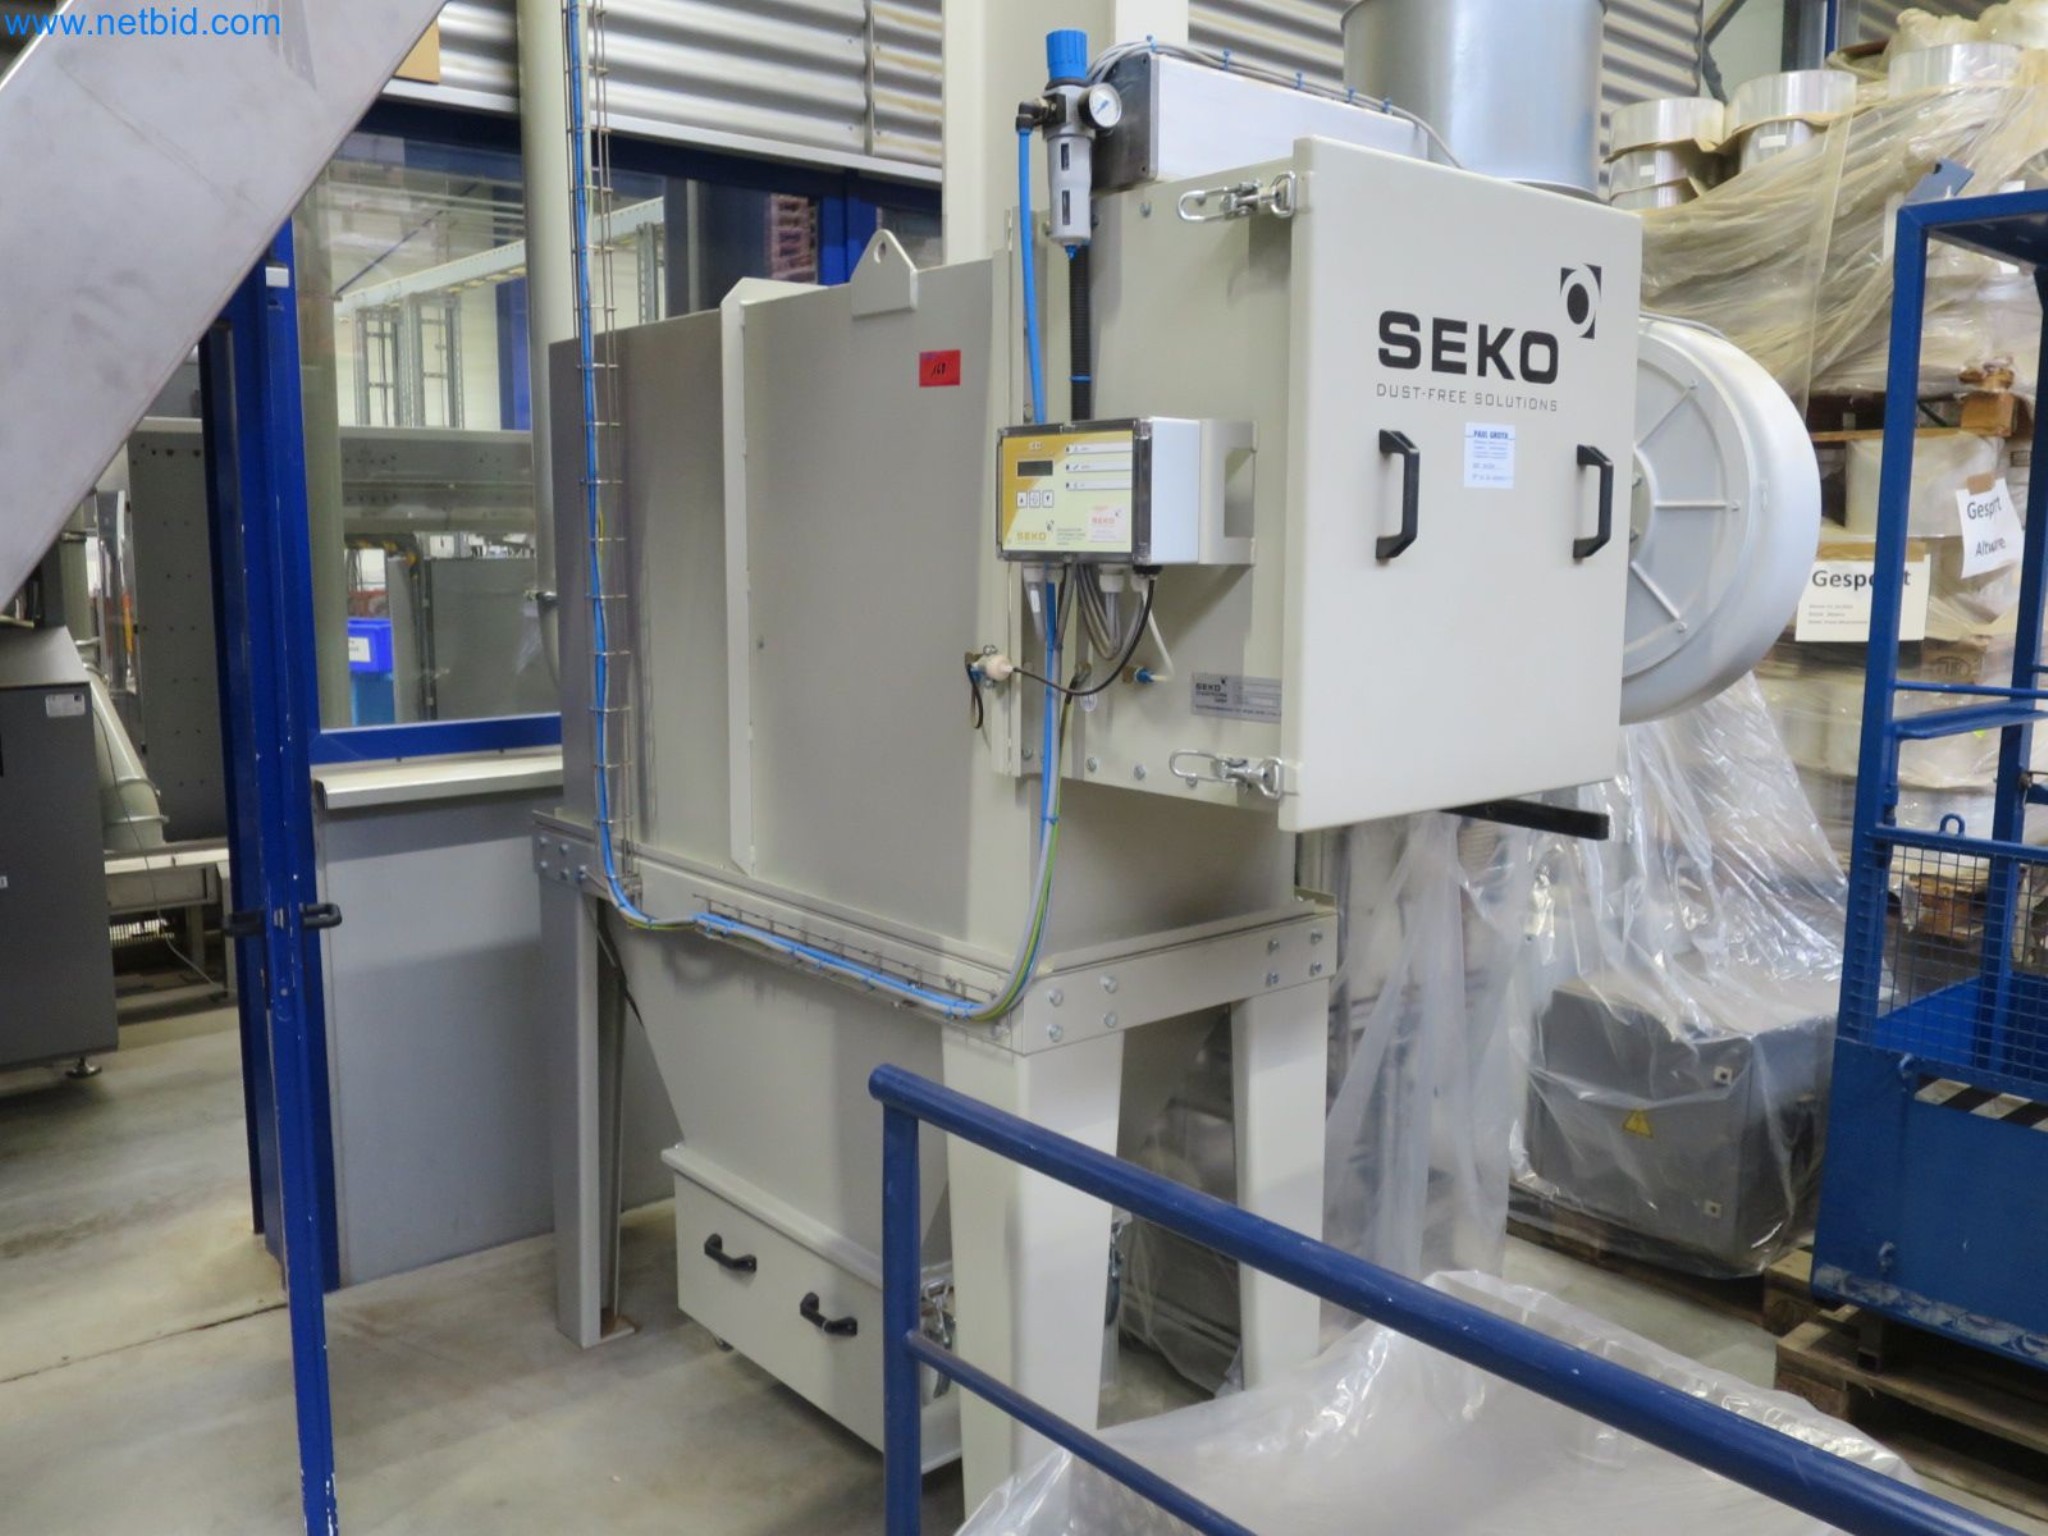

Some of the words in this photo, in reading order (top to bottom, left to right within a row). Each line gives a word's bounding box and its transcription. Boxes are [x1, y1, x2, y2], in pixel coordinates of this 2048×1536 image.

[1378, 310, 1559, 385] SEKO
[1376, 383, 1467, 404] DUST-FREE
[1474, 392, 1558, 412] SOLUTIONS
[1016, 531, 1047, 541] SEKO
